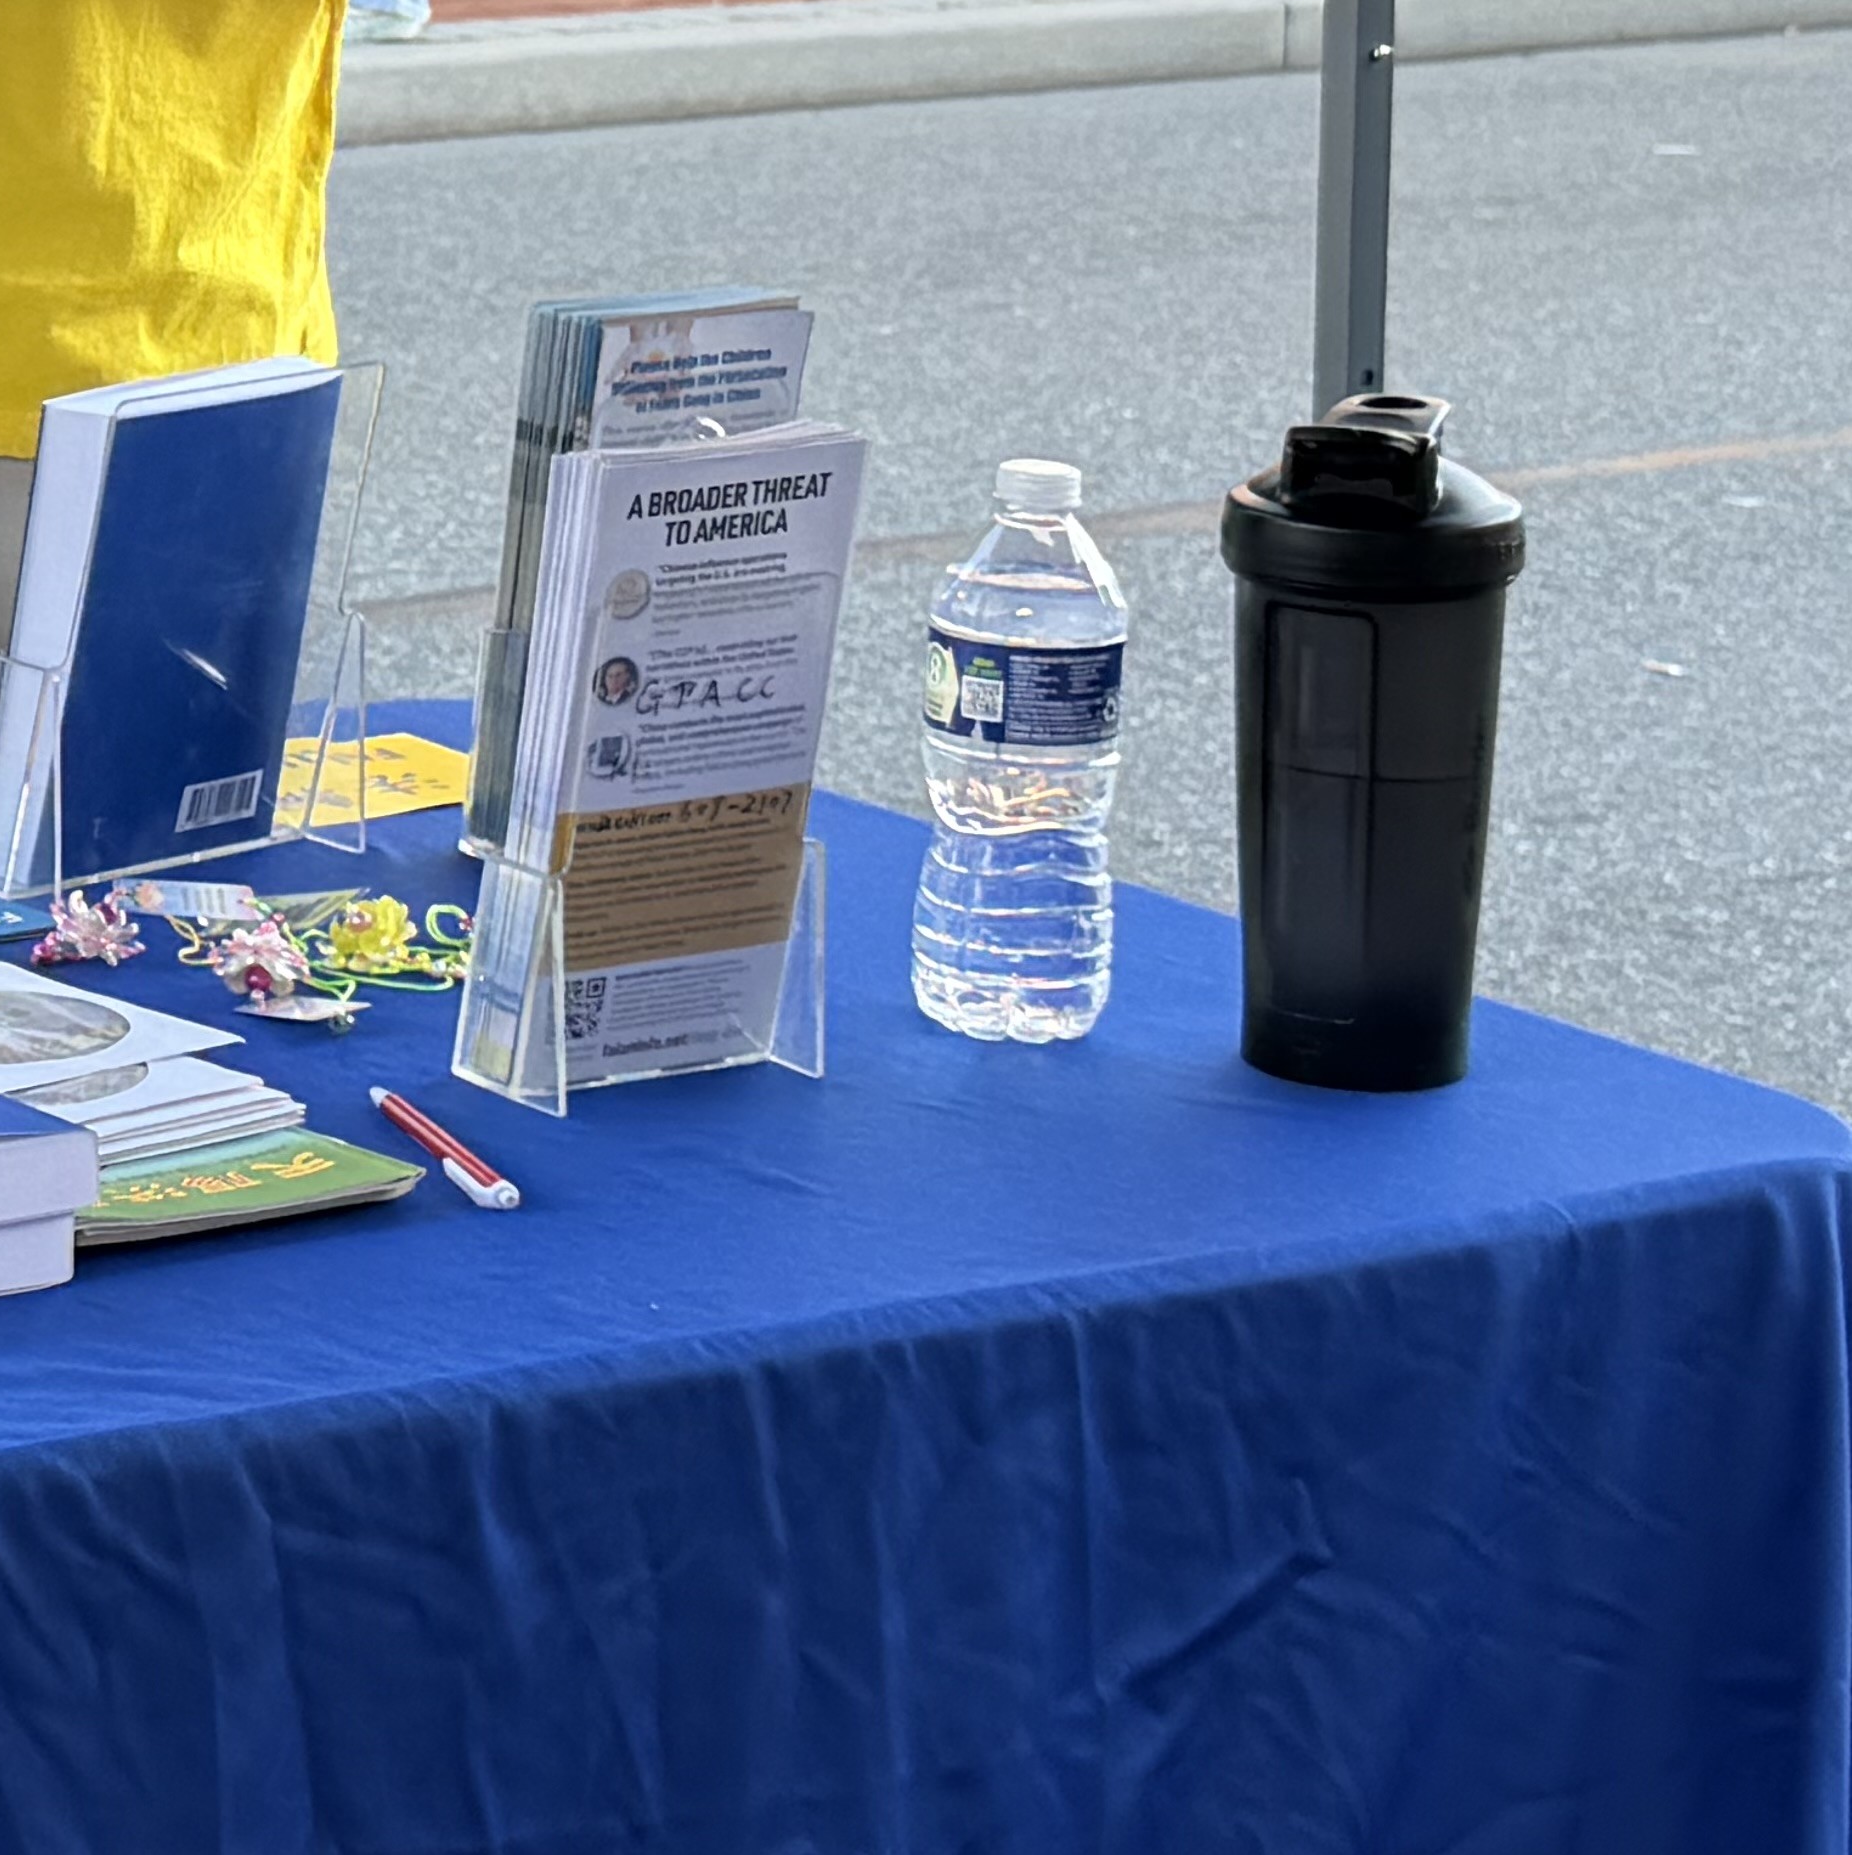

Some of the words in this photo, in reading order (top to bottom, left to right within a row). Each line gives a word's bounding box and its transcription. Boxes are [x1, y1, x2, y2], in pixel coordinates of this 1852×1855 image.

[627, 494, 644, 520] A
[647, 481, 748, 518] BROADER
[751, 471, 833, 506] THREAT
[665, 519, 691, 547] TO
[692, 507, 788, 543] AMERICA
